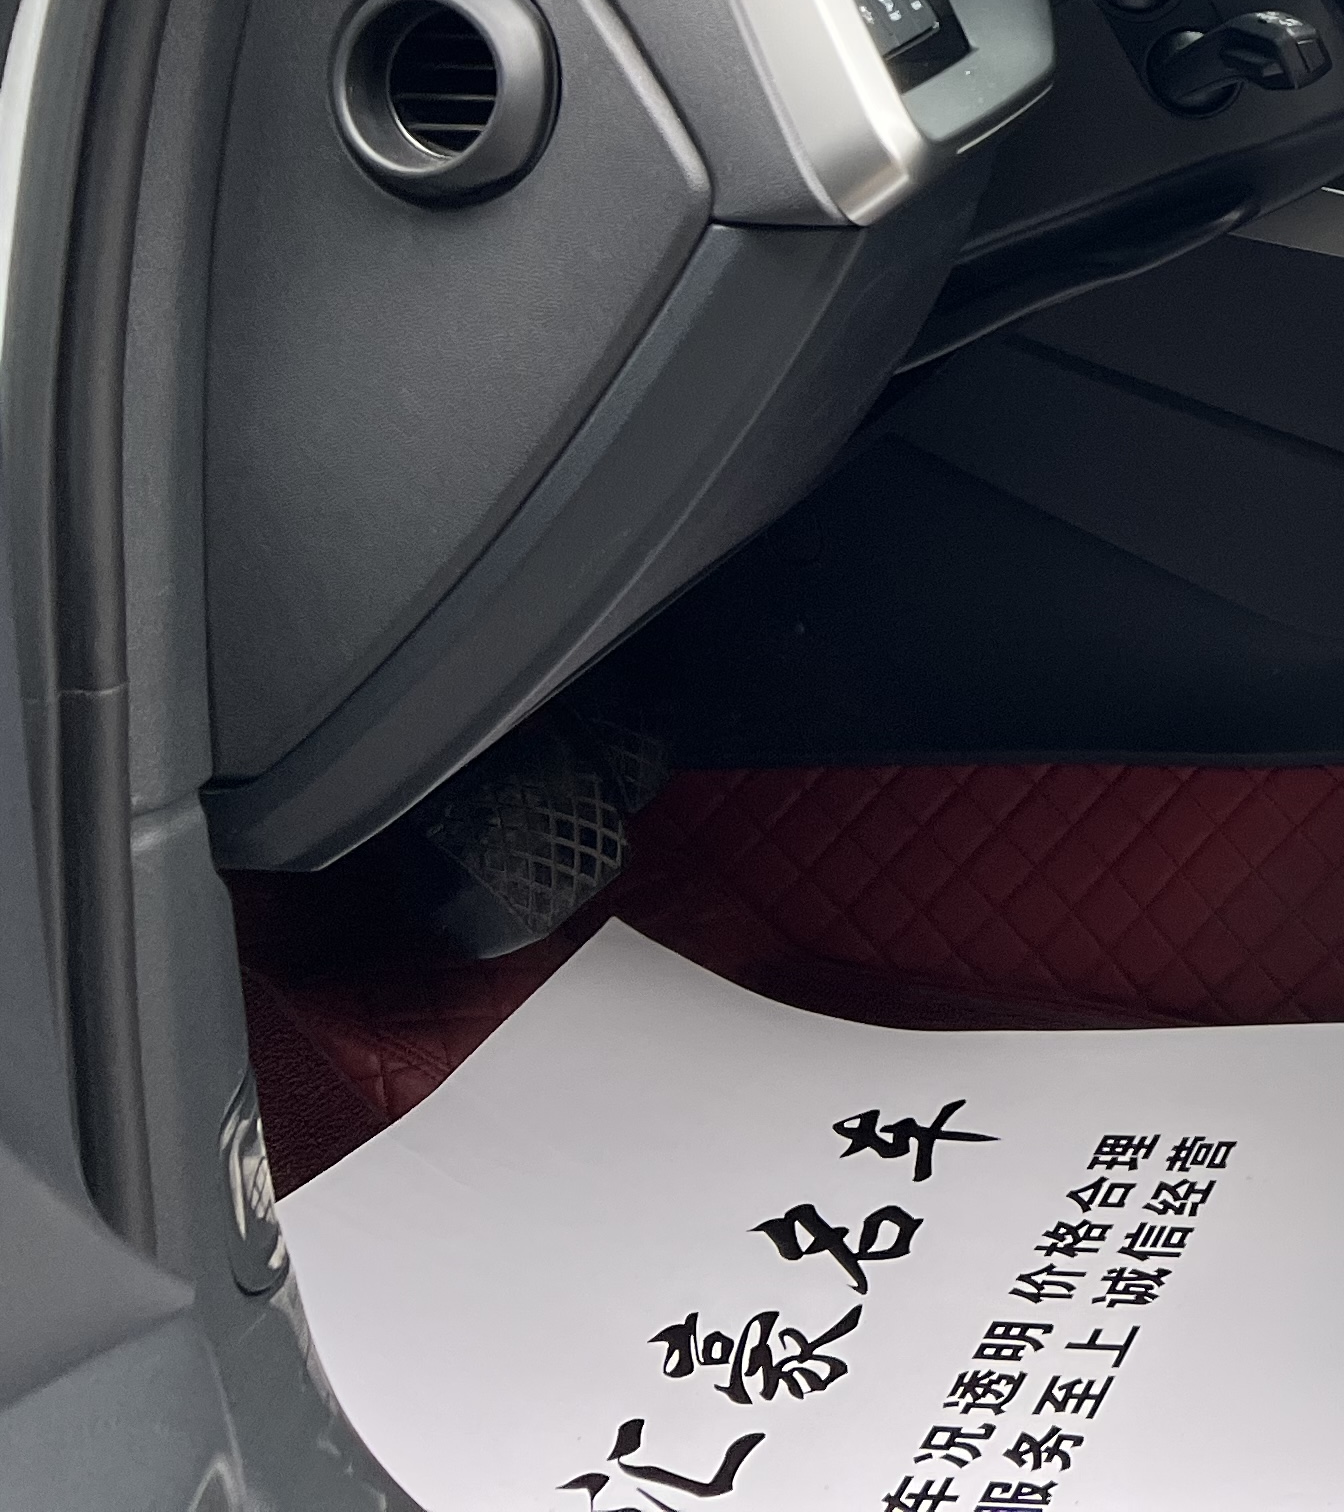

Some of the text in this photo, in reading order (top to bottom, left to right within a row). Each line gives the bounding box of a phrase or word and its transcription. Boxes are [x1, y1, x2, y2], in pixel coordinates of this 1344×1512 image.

[883, 1135, 1160, 1512] 车况透明 价格合理
[974, 1136, 1237, 1512] 服务至上 诚信经营
